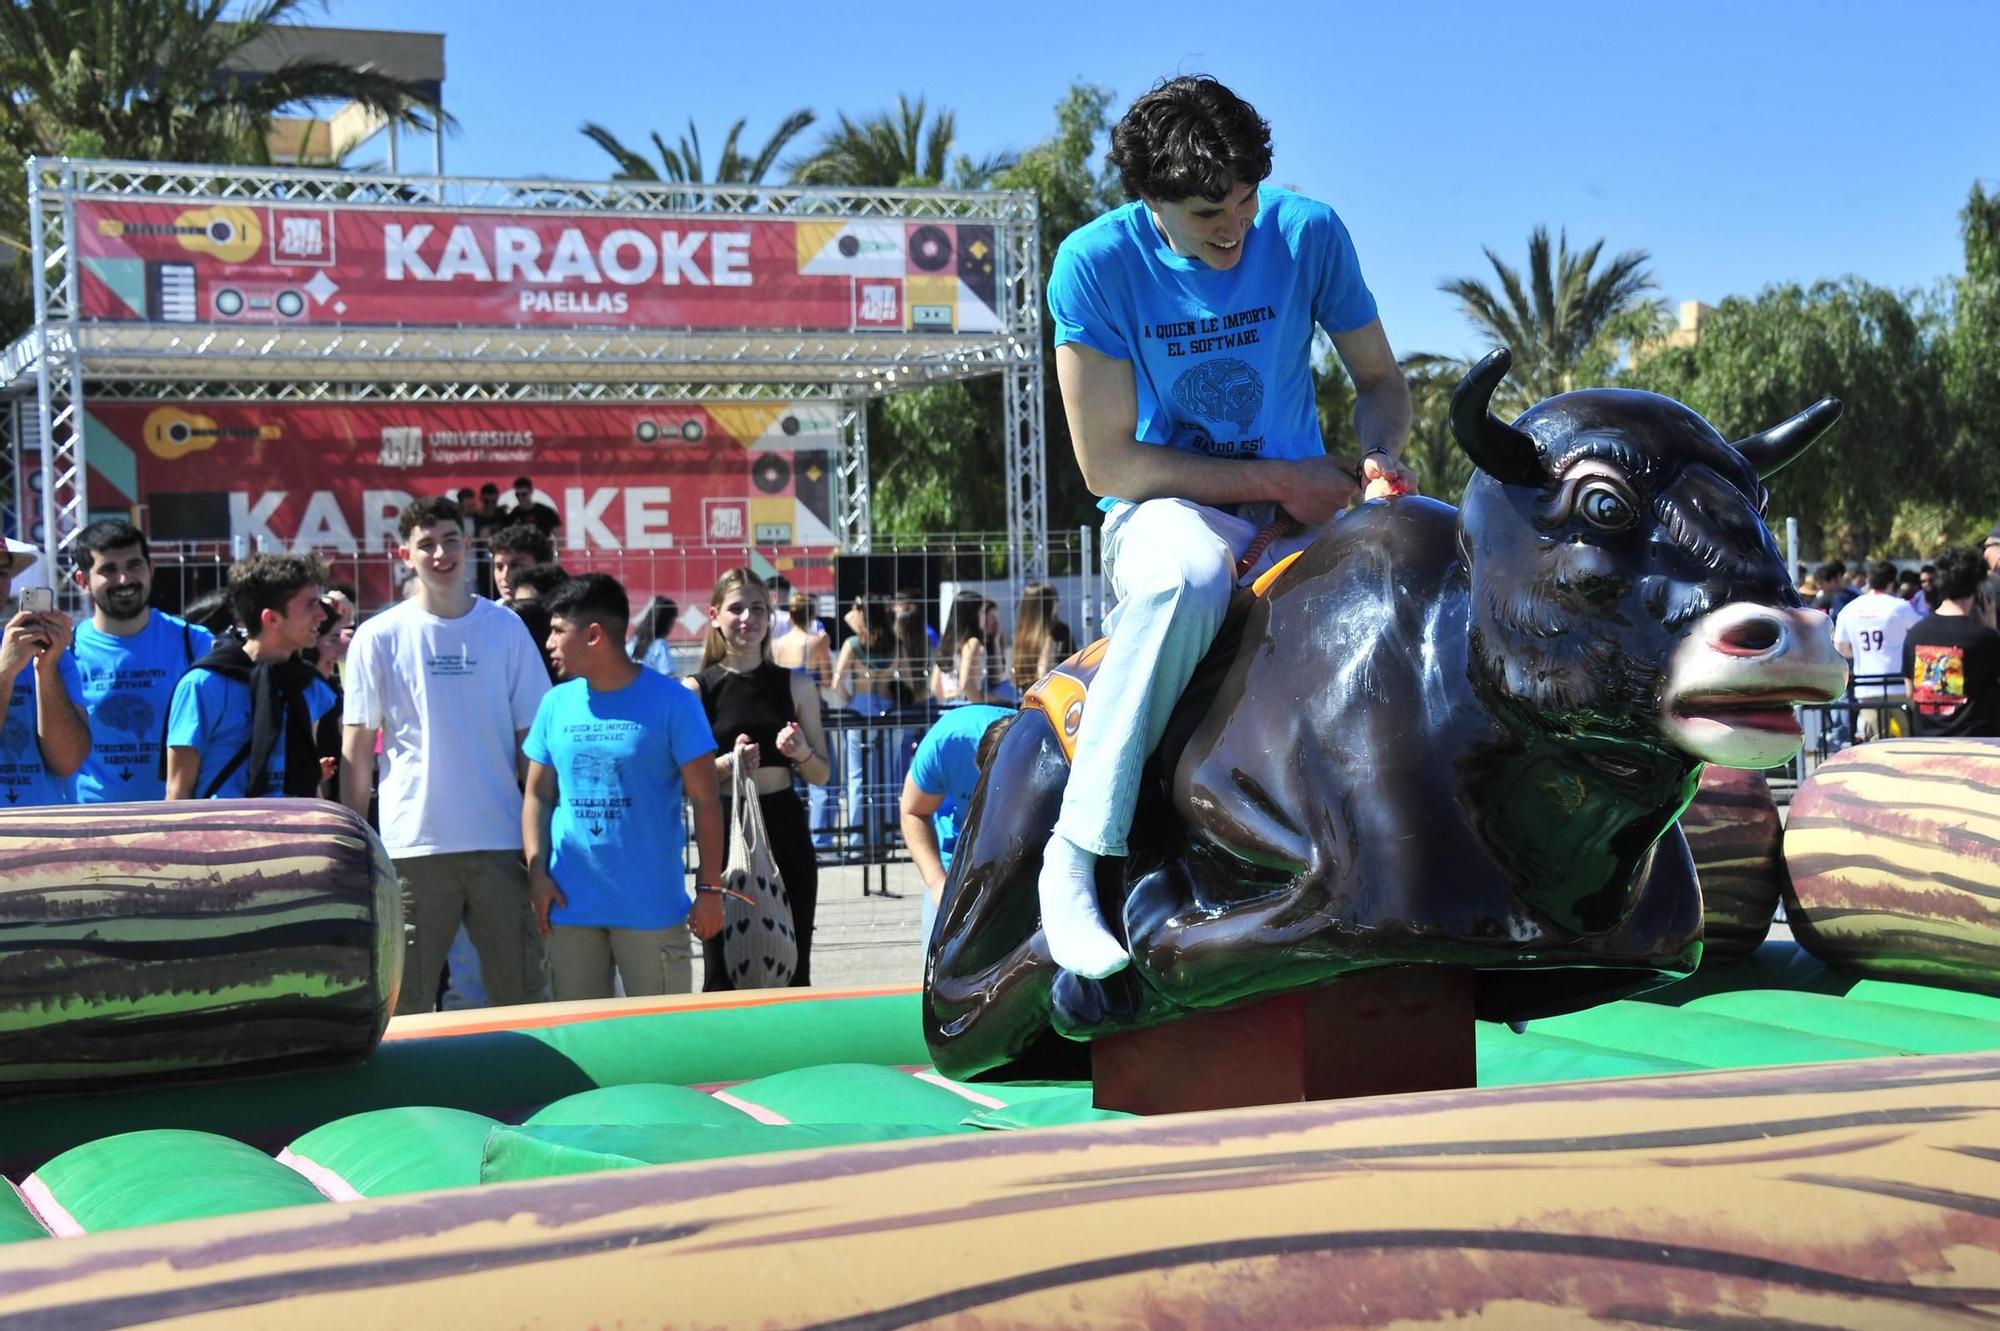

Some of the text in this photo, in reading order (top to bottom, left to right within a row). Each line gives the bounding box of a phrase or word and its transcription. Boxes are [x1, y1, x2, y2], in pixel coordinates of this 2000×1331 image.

[384, 224, 752, 286] KARAOKE
[520, 290, 629, 313] PAELLAS
[1144, 305, 1276, 340] A QUIEN LE IMPORTA
[1167, 329, 1260, 357] EL SOFTWARE
[429, 431, 534, 446] UNIVERSITAS
[1860, 630, 1884, 651] 39
